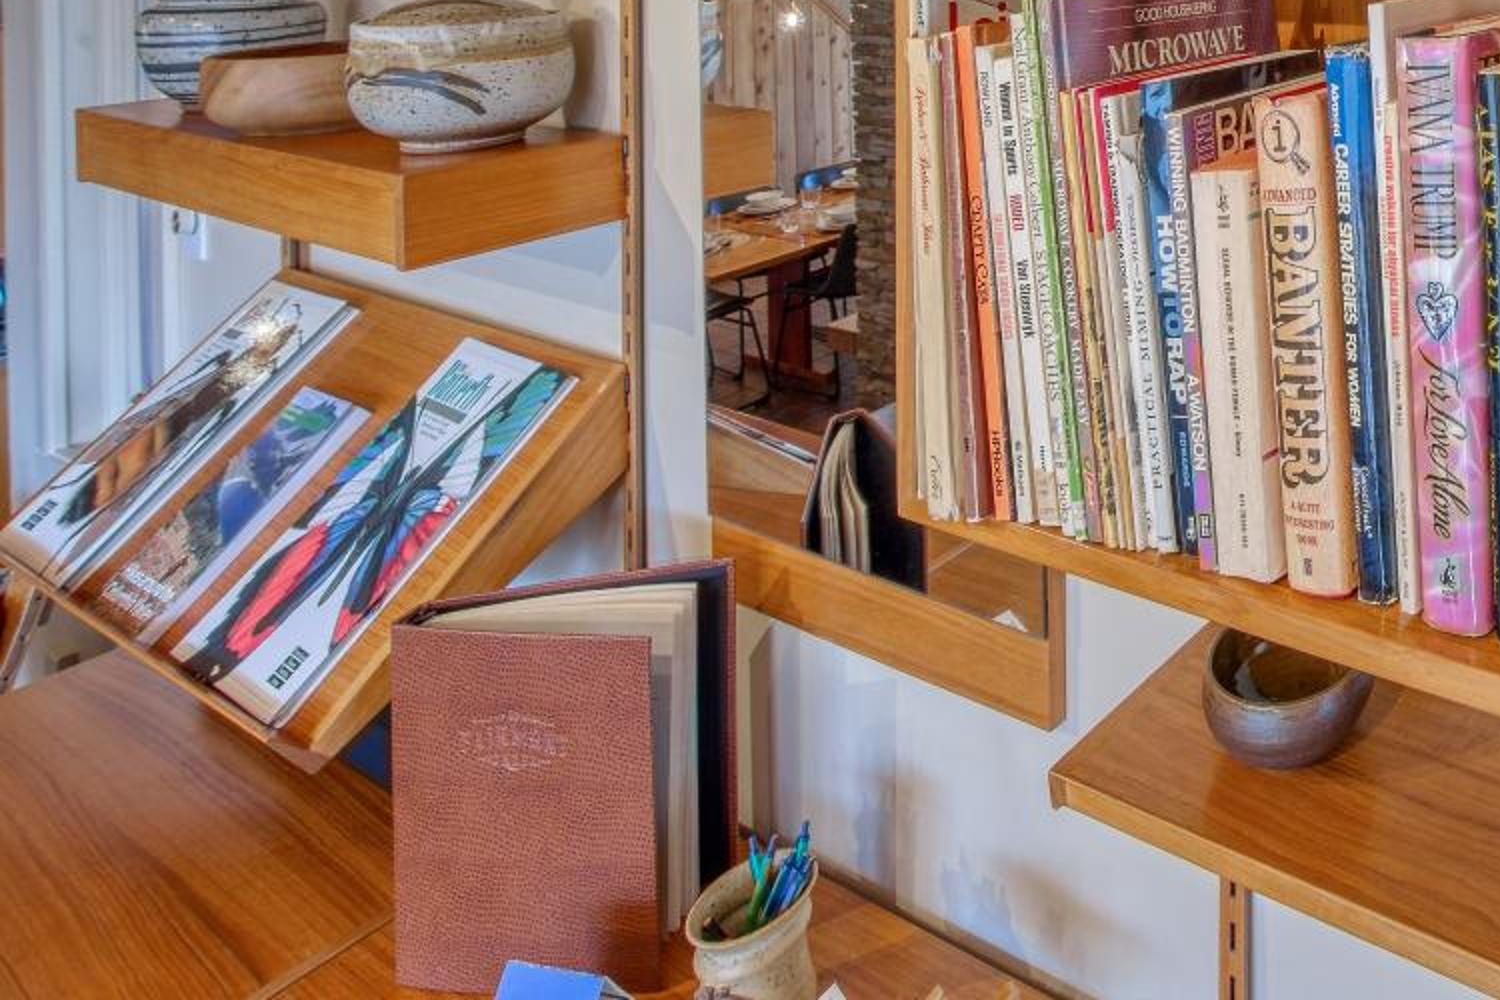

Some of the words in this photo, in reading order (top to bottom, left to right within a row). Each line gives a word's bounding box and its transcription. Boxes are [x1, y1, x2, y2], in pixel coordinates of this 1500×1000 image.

[1135, 6, 1162, 23] GOOD
[1108, 24, 1245, 75] MICROWAVE
[980, 71, 992, 128] ROWLAND
[1405, 64, 1452, 154] IVANA
[1004, 140, 1018, 177] Sports
[1168, 127, 1187, 212] WINNING
[1334, 144, 1351, 215] CAREER
[1009, 193, 1025, 232] RODEO
[1054, 158, 1069, 248] MICROWAVE
[1410, 164, 1457, 259] TRUMP
[1157, 215, 1177, 290] HOW
[1175, 219, 1195, 333] BADMINTON
[1338, 221, 1358, 325] STRATEGIES
[1164, 293, 1185, 337] TO
[1344, 332, 1359, 362] FOR
[1071, 339, 1083, 385] MADE
[1167, 338, 1188, 405] RAP
[1418, 346, 1460, 404] For
[1075, 388, 1089, 426] EASY
[1347, 365, 1362, 428] WOMEN
[1422, 385, 1468, 458] Love
[1142, 373, 1162, 490] PRACTICAL
[1424, 452, 1471, 539] Alone
